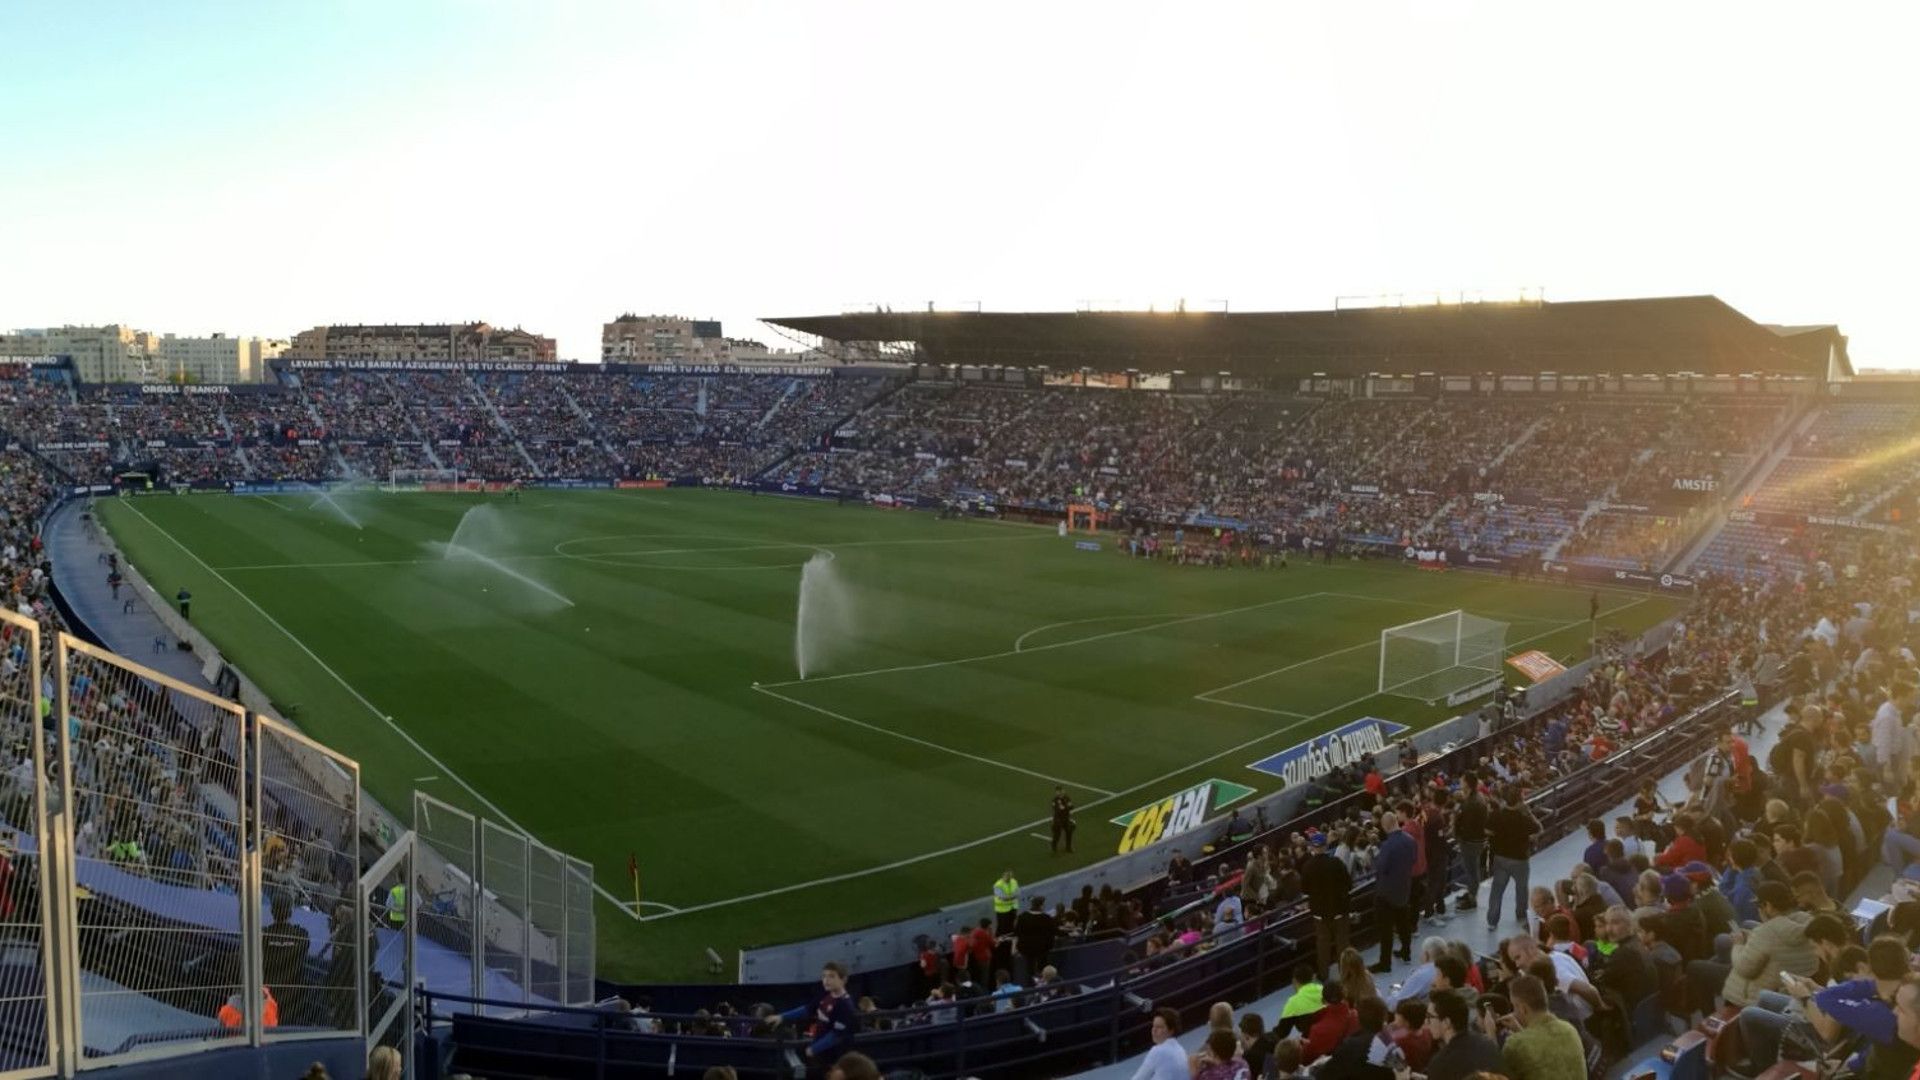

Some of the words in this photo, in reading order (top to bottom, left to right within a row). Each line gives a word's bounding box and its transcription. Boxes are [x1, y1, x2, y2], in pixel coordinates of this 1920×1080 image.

[348, 360, 365, 369] LAS
[368, 360, 402, 369] BARRAS
[468, 362, 479, 370] DE
[482, 362, 493, 370] TU
[535, 363, 567, 371] JERSEY
[724, 366, 737, 374] EL
[783, 367, 795, 375] TE
